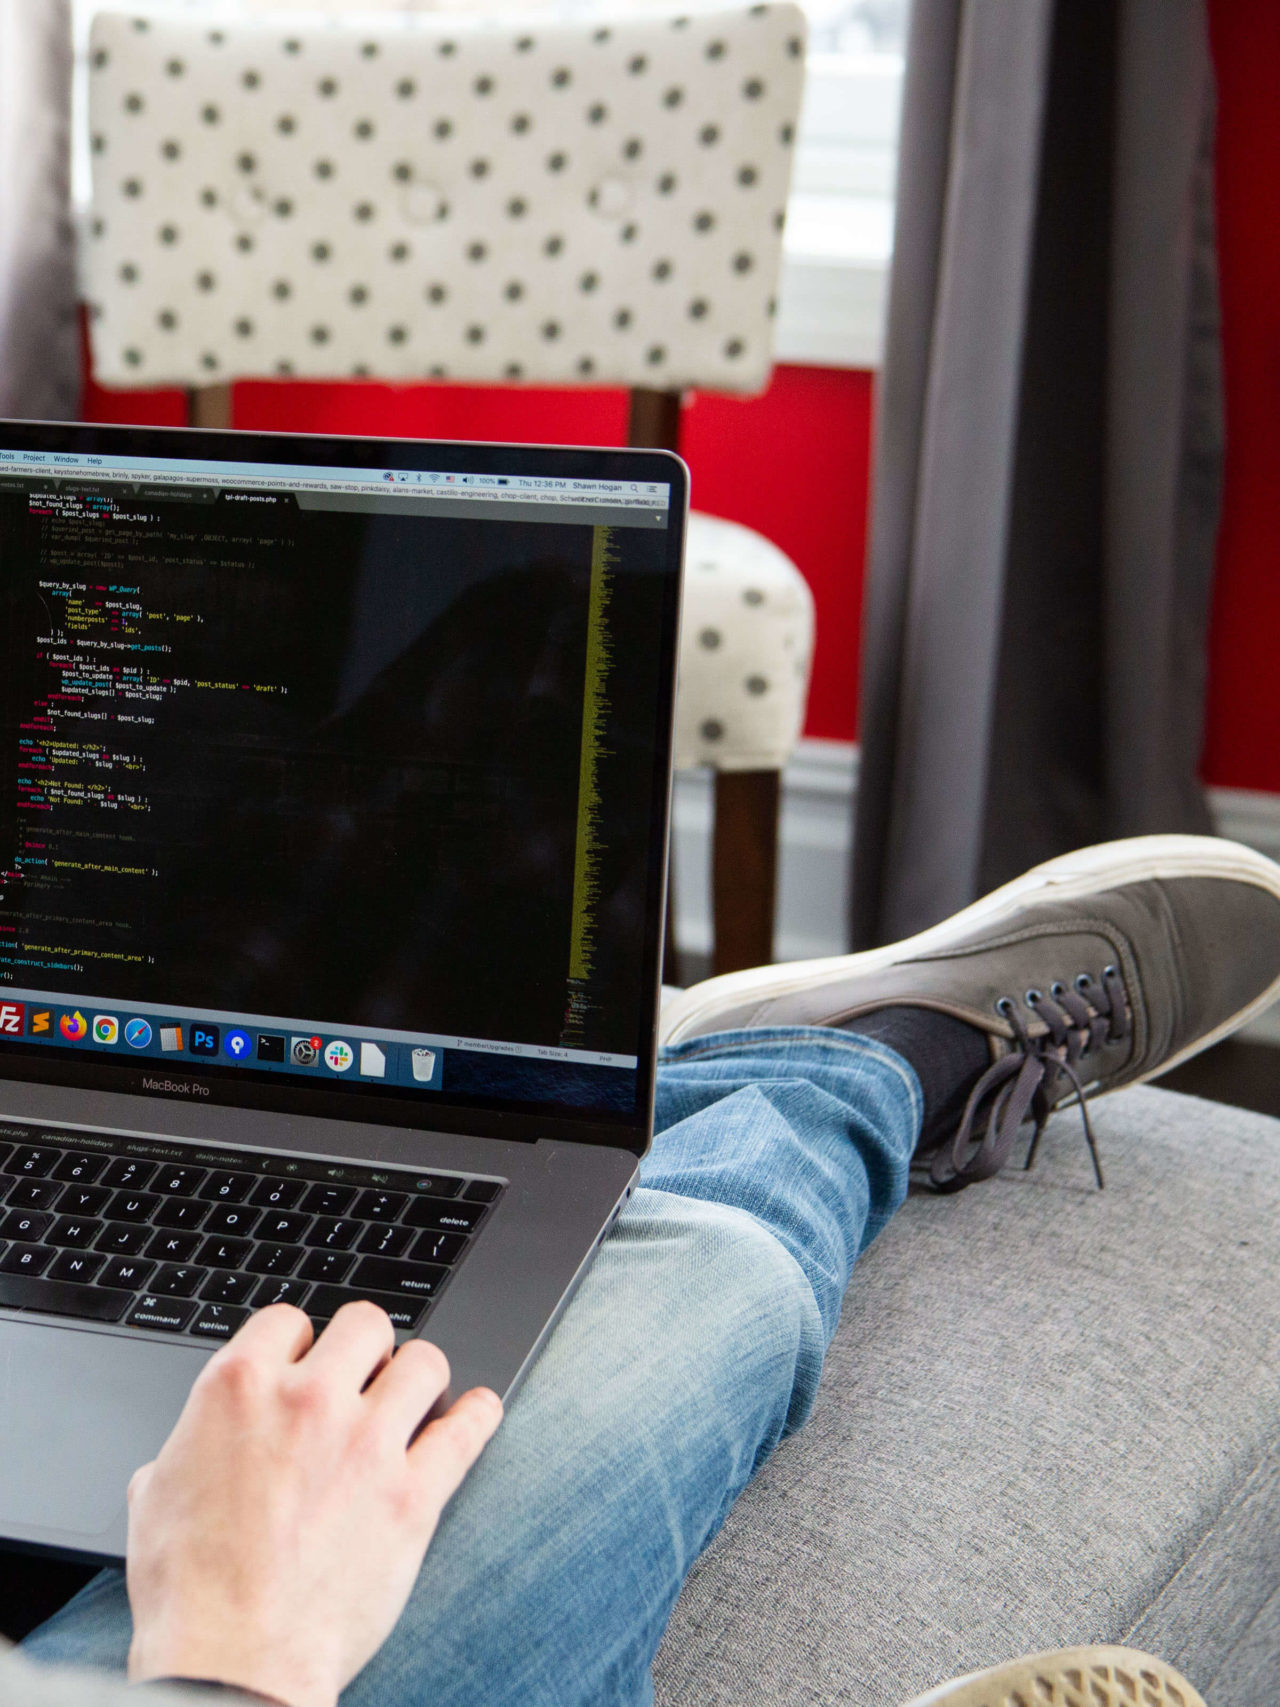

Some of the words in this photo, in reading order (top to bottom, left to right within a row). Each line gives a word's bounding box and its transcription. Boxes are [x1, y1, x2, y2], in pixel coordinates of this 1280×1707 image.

[23, 454, 44, 463] Project
[53, 455, 78, 463] Window
[87, 457, 102, 466] Help
[598, 483, 621, 492] Hogan
[225, 493, 276, 503] tpl-draft-posts.php
[29, 500, 83, 510] $not_found_slugs
[62, 510, 99, 518] $post_slugs
[112, 513, 147, 521] $post_slug
[38, 580, 86, 590] $query_by_slug
[36, 636, 67, 645] $post_ids
[61, 670, 112, 681] $post_to_update
[51, 749, 99, 759] $updated_slugs
[195, 1032, 213, 1048] Ps
[143, 1078, 189, 1093] MacBook
[193, 1084, 209, 1095] Pro
[41, 1134, 114, 1148] canadian-holidays
[24, 1161, 34, 1169] 5
[32, 1189, 40, 1197] T
[81, 1195, 88, 1203] Y
[127, 1202, 138, 1210] U
[227, 1215, 238, 1223] O
[20, 1221, 30, 1229] G
[68, 1227, 80, 1235] H
[119, 1234, 128, 1242] J
[168, 1241, 178, 1249] K
[219, 1247, 225, 1256] L
[21, 1254, 32, 1262] B
[71, 1261, 82, 1270] N
[120, 1268, 133, 1277] M
[402, 1281, 430, 1289] return
[135, 1313, 180, 1324] command
[199, 1322, 229, 1330] option
